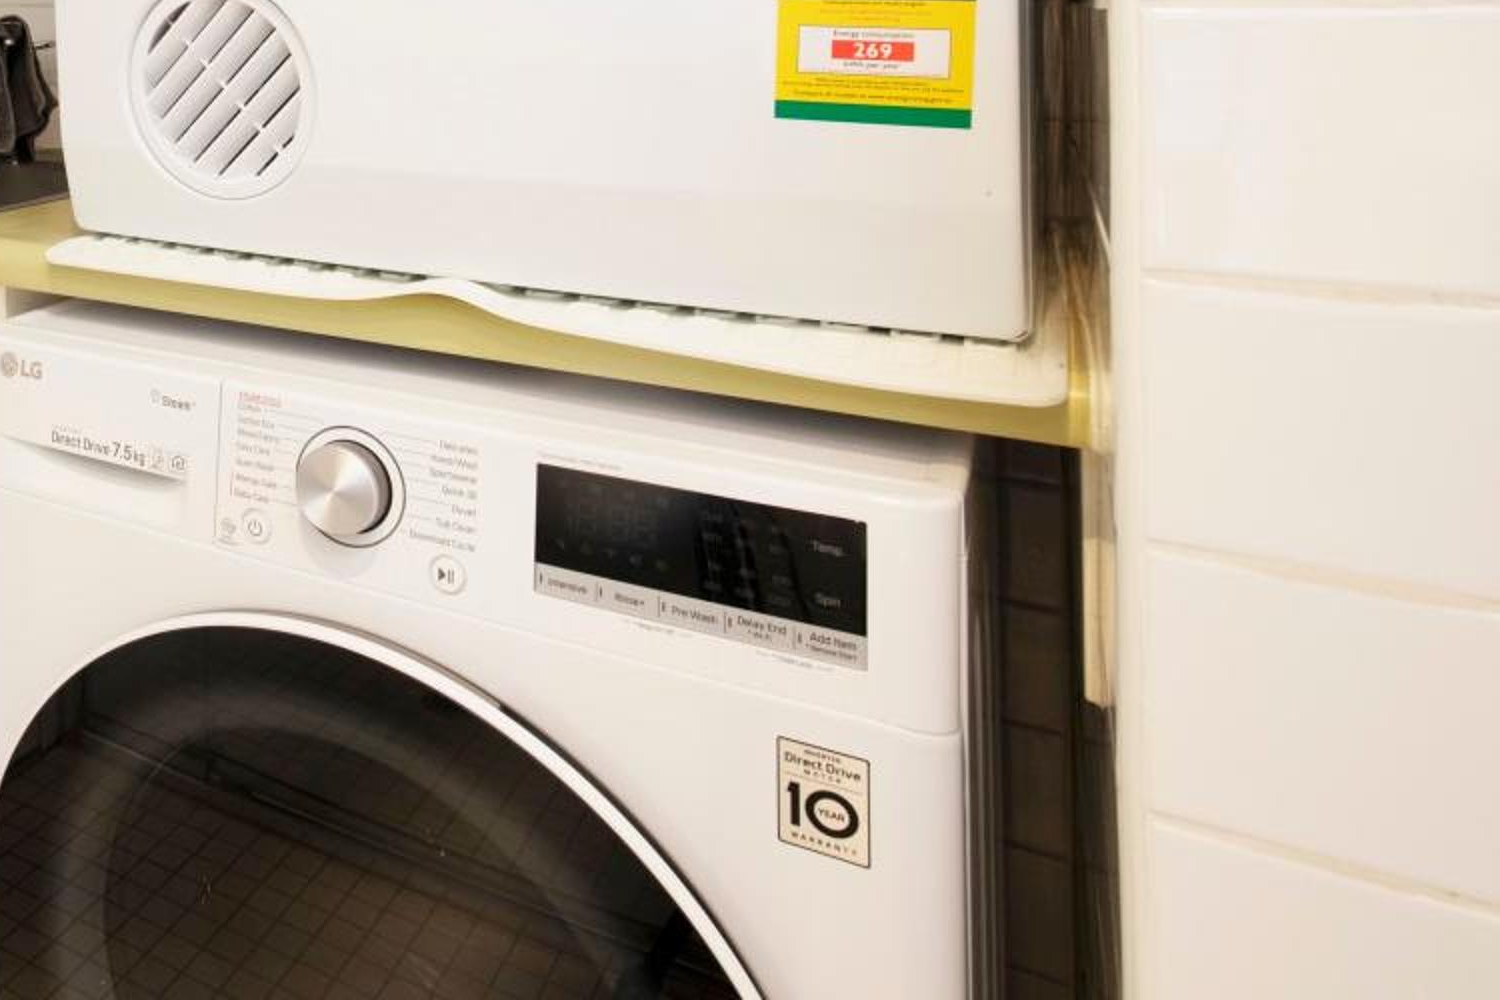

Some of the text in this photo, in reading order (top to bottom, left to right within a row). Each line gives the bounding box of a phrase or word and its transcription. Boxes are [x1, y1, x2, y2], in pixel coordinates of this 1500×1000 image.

[852, 42, 894, 59] 269
[20, 359, 43, 380] LG
[51, 430, 81, 450] Direct
[83, 436, 110, 456] Drive
[691, 609, 716, 624] Wash
[737, 615, 788, 636] Delay End
[809, 631, 857, 651] Add Item
[784, 751, 861, 781] Direct Drive
[787, 780, 860, 840] 10
[818, 807, 846, 823] YEAR
[791, 831, 858, 856] WARRANTY
